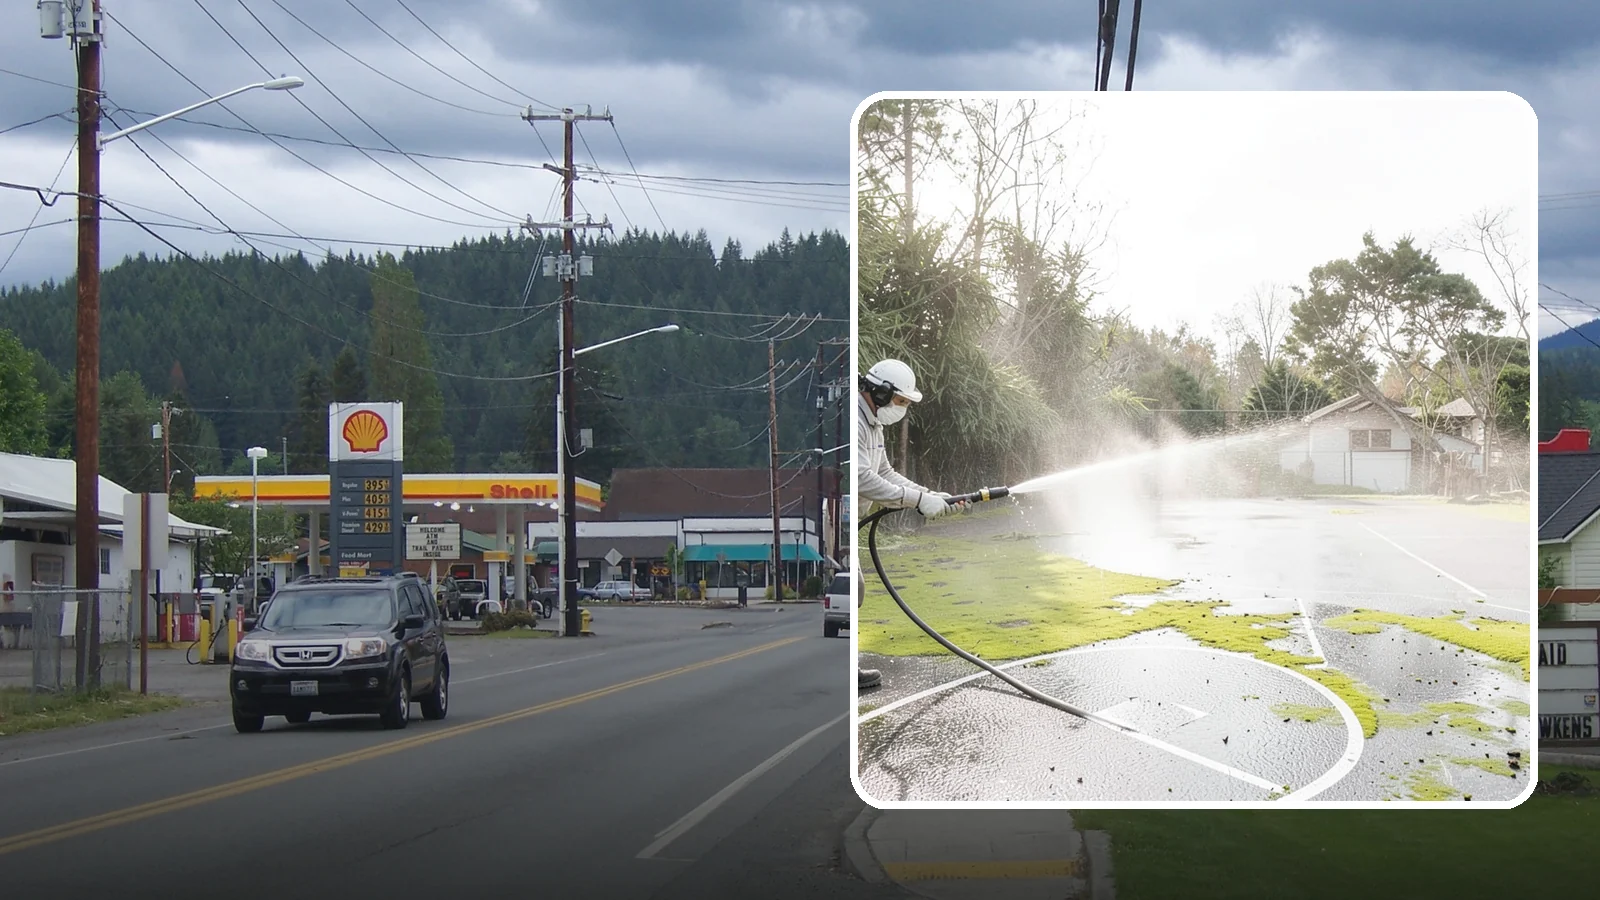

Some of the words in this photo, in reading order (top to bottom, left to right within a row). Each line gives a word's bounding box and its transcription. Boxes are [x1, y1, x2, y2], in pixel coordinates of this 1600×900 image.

[366, 480, 384, 490] 395
[490, 484, 547, 499] Shell
[365, 494, 384, 504] 405
[365, 508, 384, 518] 415
[365, 522, 384, 533] 429
